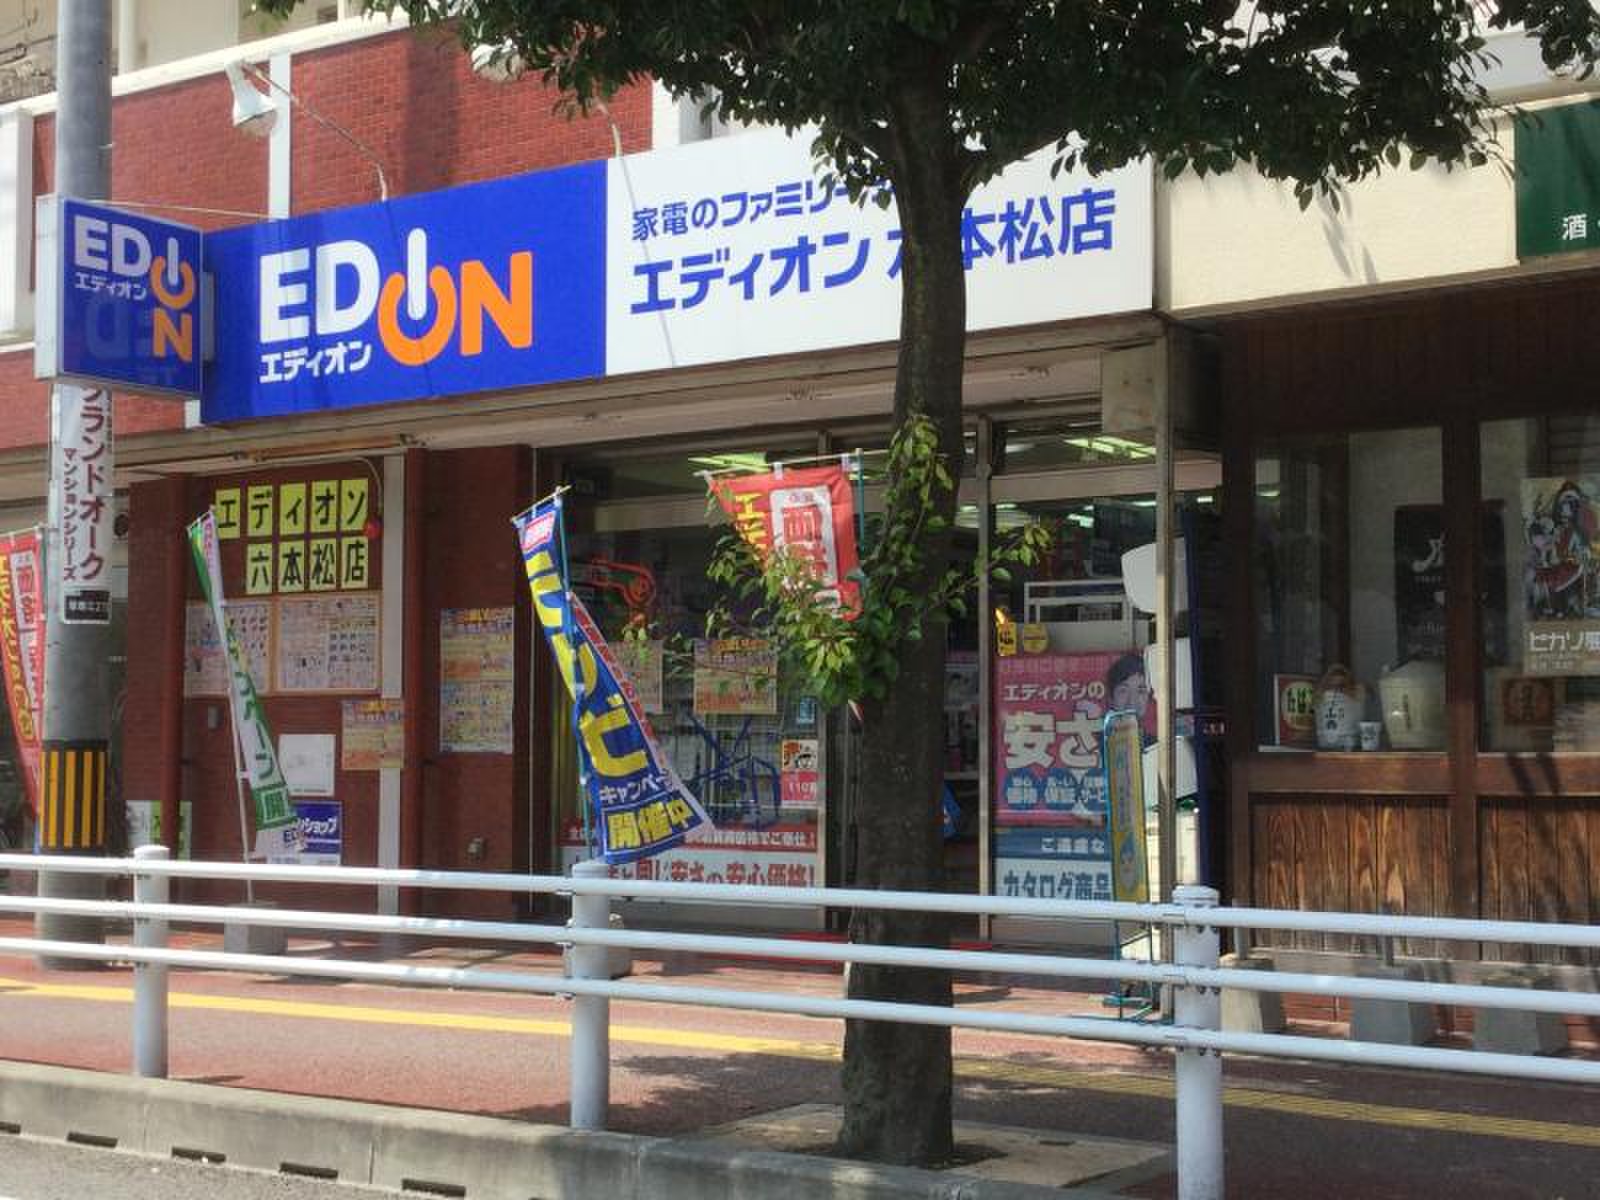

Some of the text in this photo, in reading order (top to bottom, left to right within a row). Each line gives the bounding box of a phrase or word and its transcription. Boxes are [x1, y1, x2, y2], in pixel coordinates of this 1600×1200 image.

[1562, 213, 1588, 241] 酒
[74, 215, 195, 362] EDION
[75, 271, 148, 301] エディオン
[630, 231, 871, 315] エディオン
[260, 228, 533, 366] EDION
[259, 340, 373, 384] エディオン
[218, 485, 366, 531] エディオン
[245, 539, 366, 590] 六本松店
[1003, 679, 1105, 701] エディオンの
